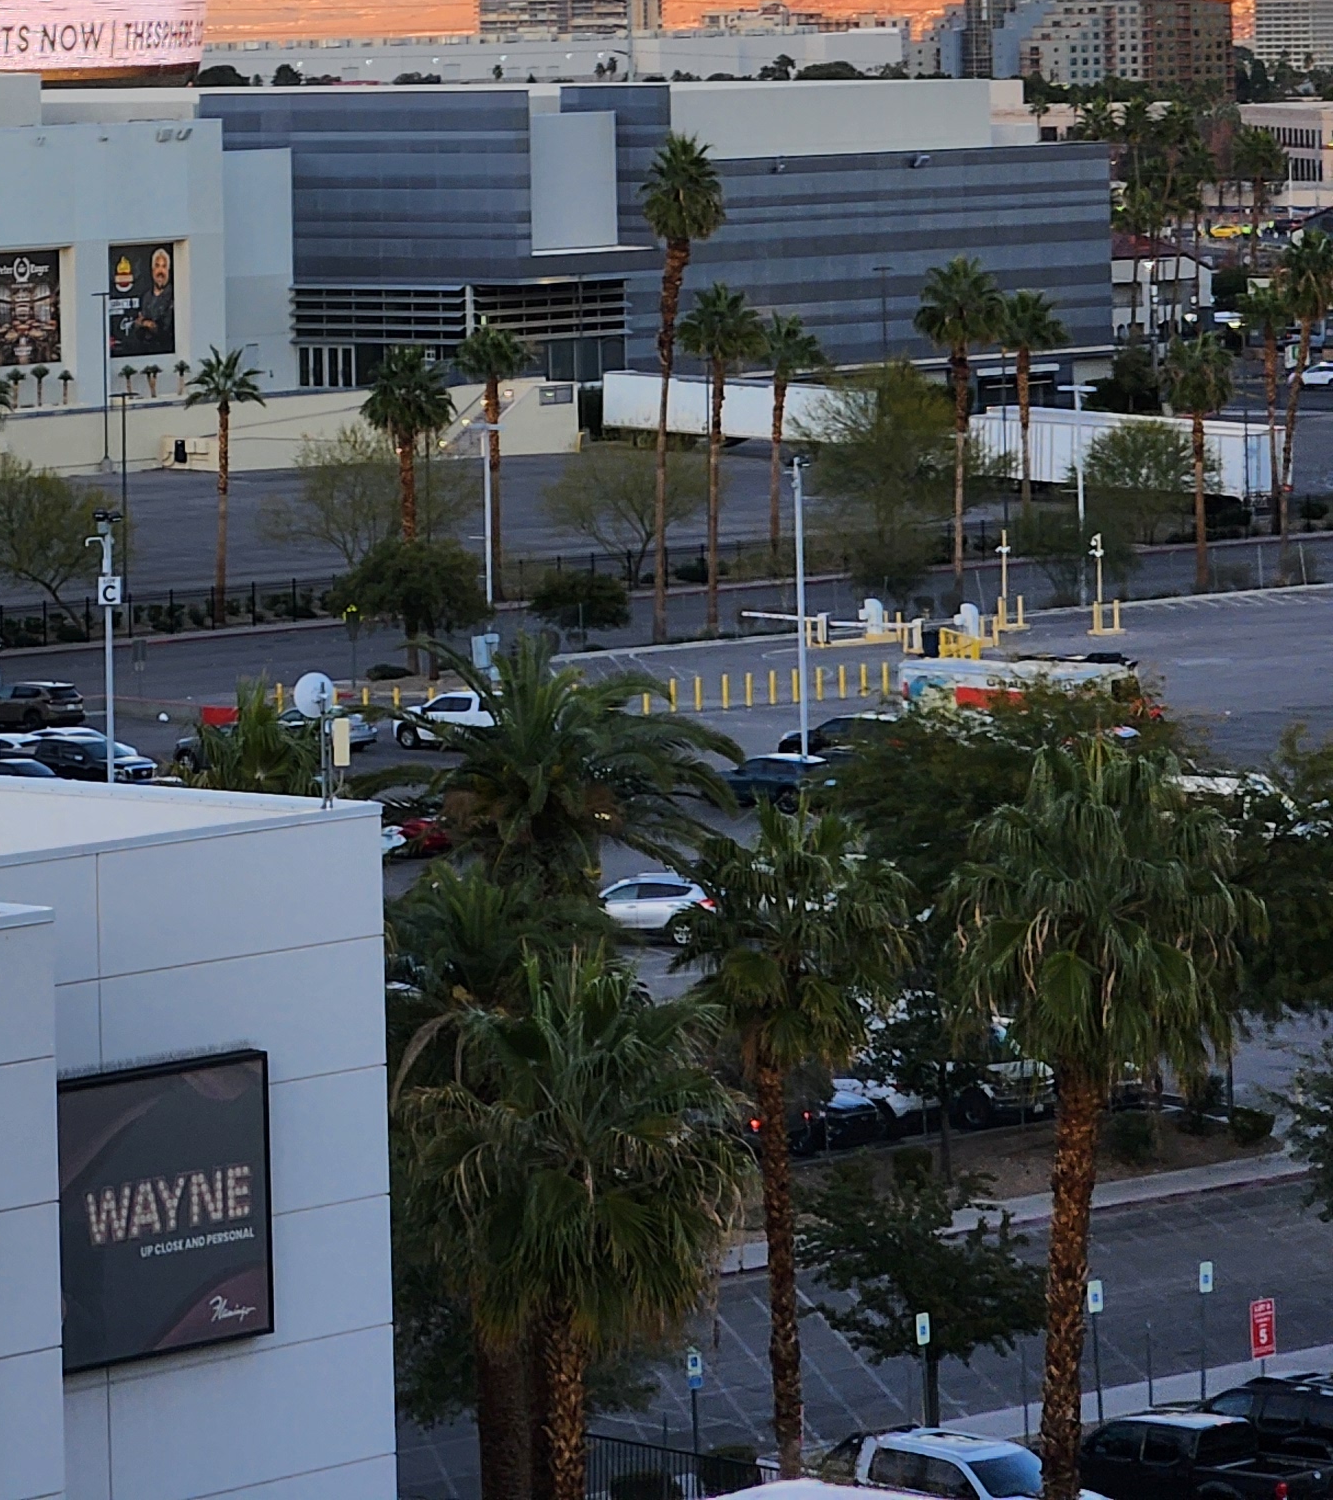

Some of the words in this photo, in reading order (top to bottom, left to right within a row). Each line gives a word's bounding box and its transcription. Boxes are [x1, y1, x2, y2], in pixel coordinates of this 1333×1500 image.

[40, 21, 105, 55] NOW
[102, 585, 117, 603] C
[86, 1164, 252, 1246] WAYNE
[140, 1245, 154, 1258] UP
[154, 1238, 184, 1256] CLOSE
[184, 1235, 206, 1250] AND
[206, 1226, 255, 1246] PERSONAL
[1259, 1328, 1268, 1345] 5
